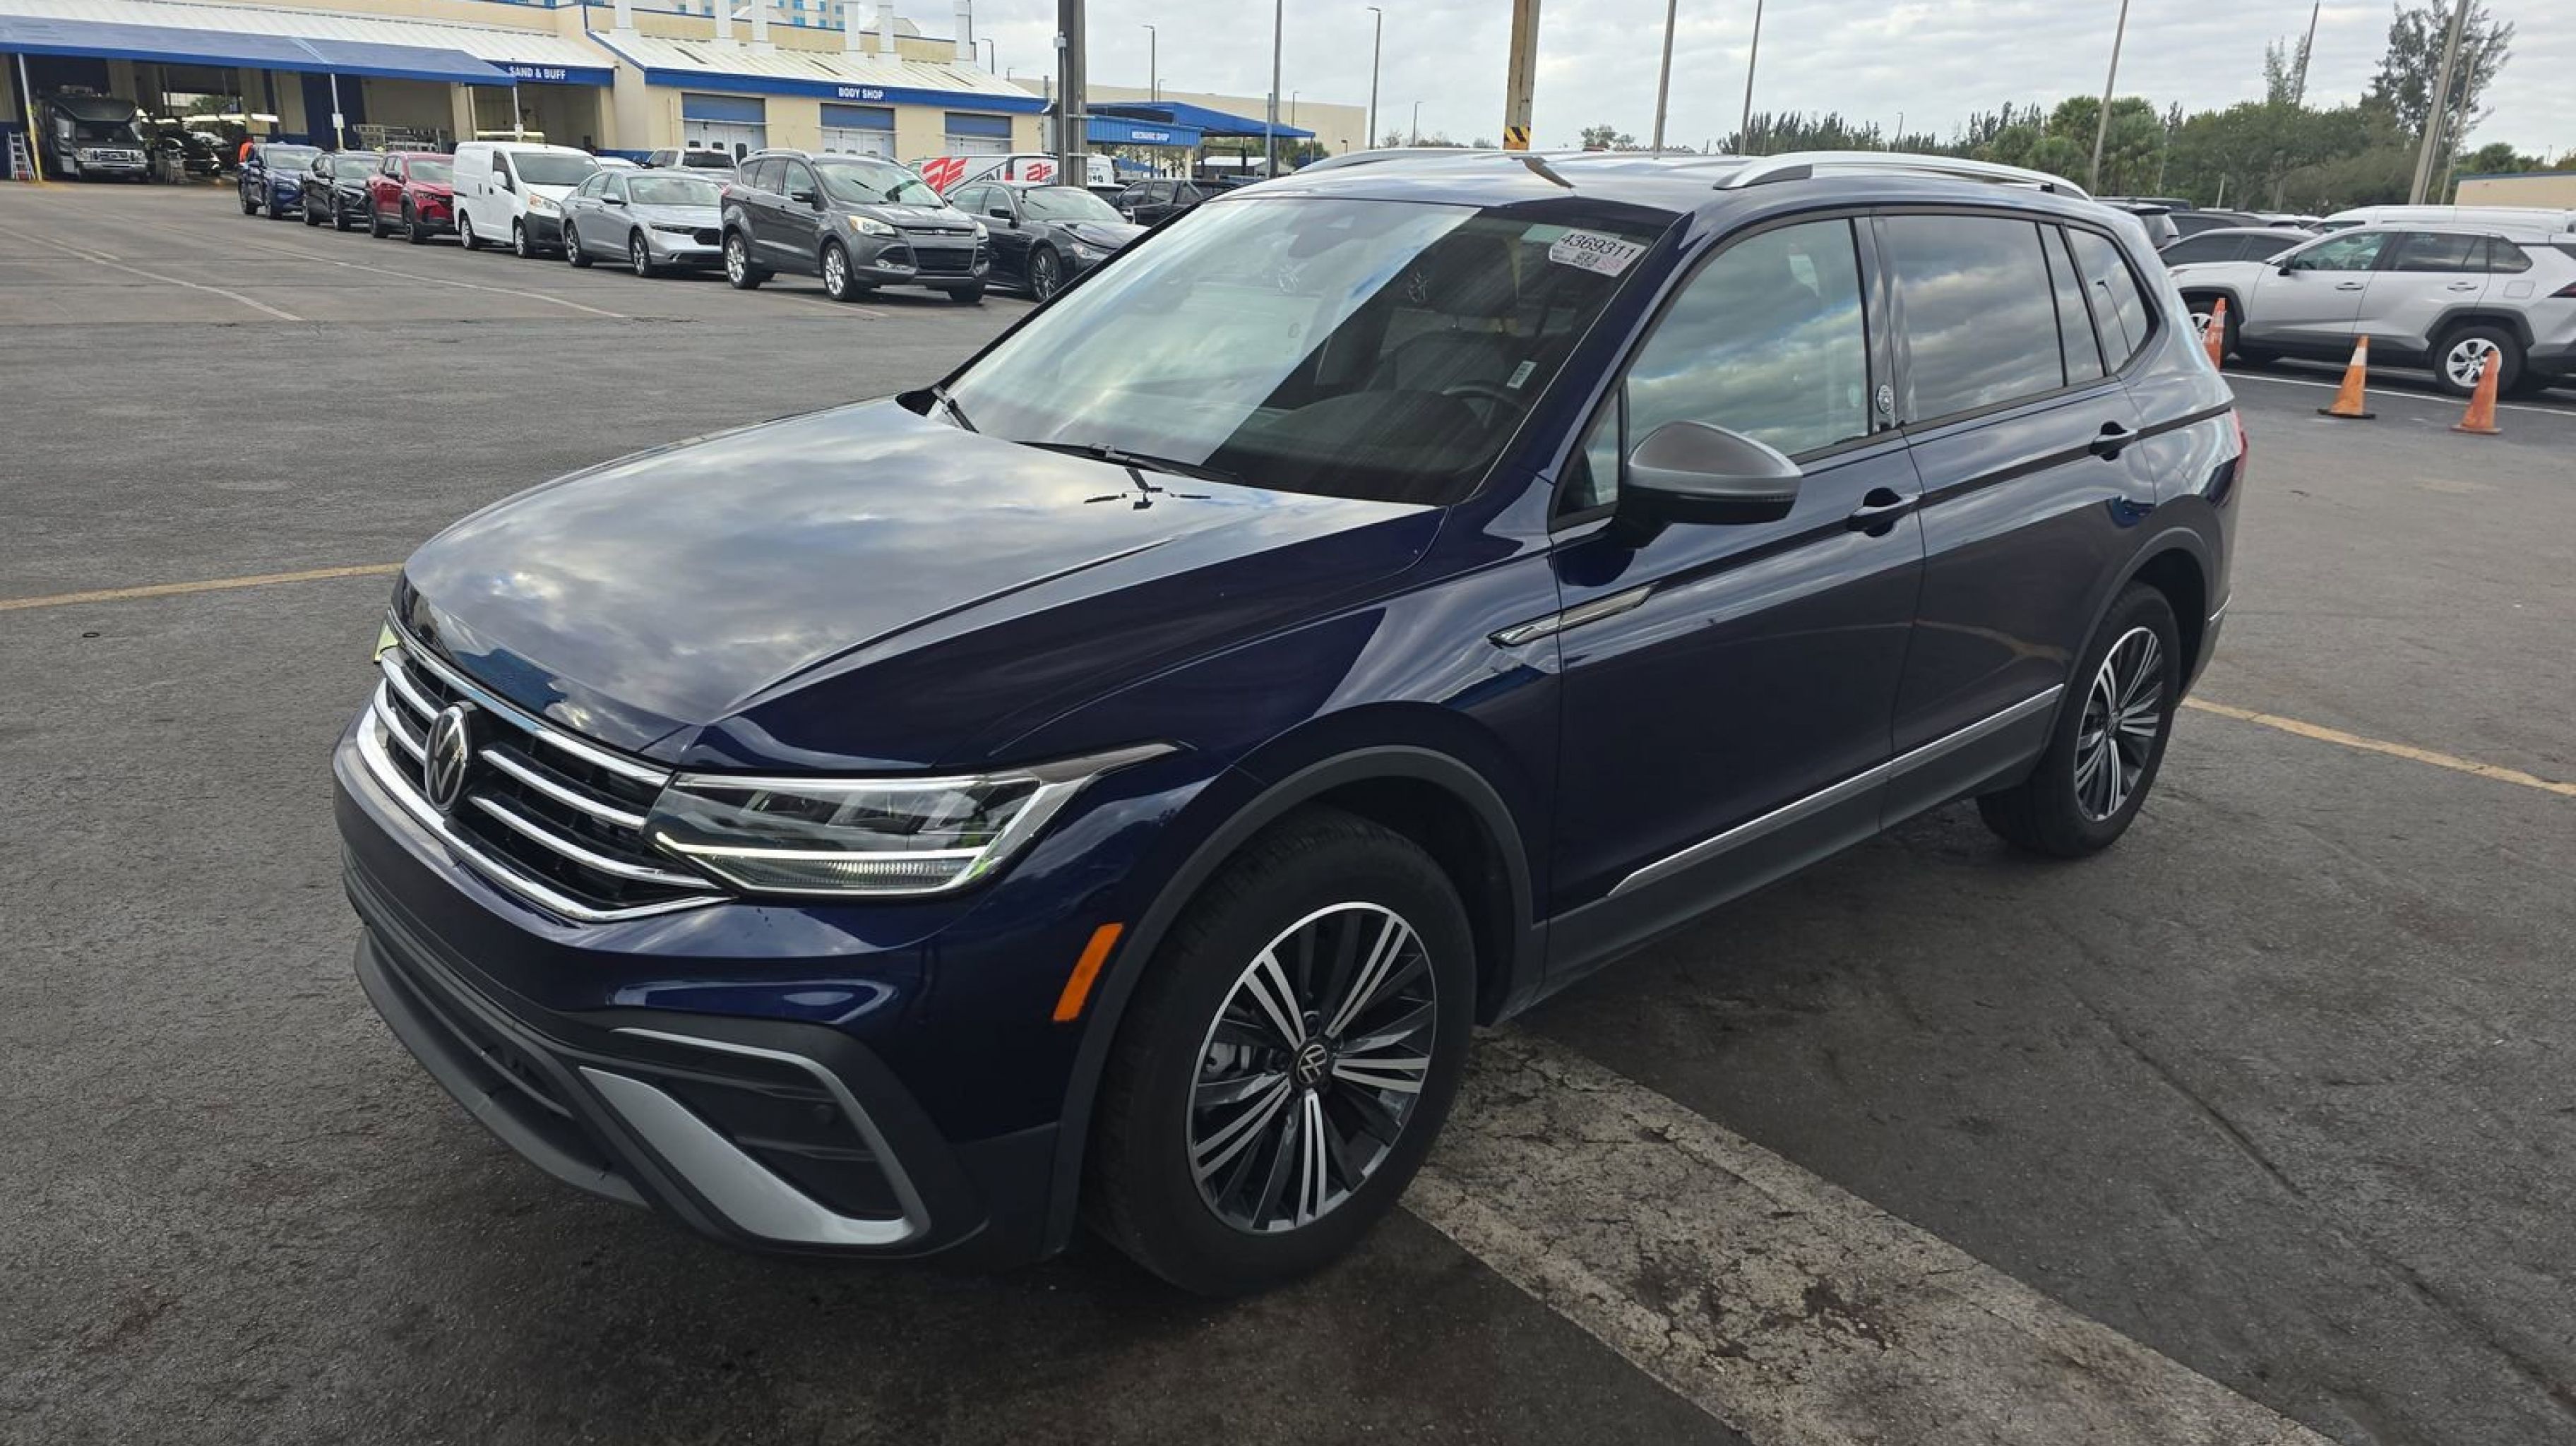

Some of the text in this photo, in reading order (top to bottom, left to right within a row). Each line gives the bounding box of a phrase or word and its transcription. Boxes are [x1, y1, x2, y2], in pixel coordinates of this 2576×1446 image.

[838, 87, 883, 100] BODY SHOP
[1561, 234, 1637, 259] 4369311
